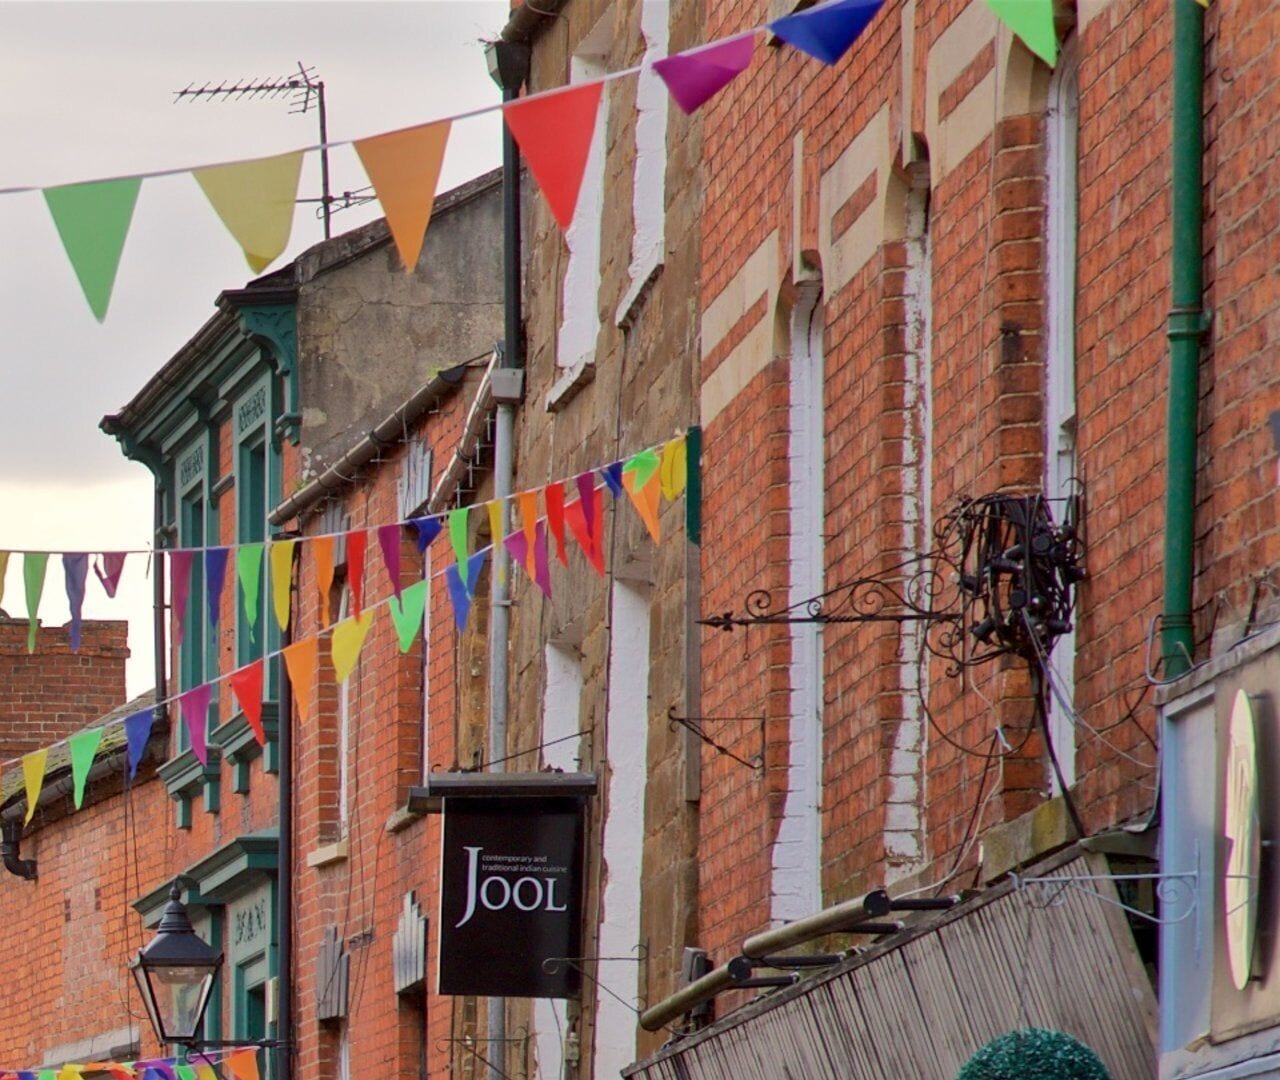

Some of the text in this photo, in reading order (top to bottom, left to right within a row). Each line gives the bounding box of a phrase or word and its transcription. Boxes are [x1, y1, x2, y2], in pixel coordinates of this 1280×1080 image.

[482, 855, 532, 863] contemporary
[482, 864, 567, 873] traditional indian cuisine
[455, 846, 567, 928] JOOL
